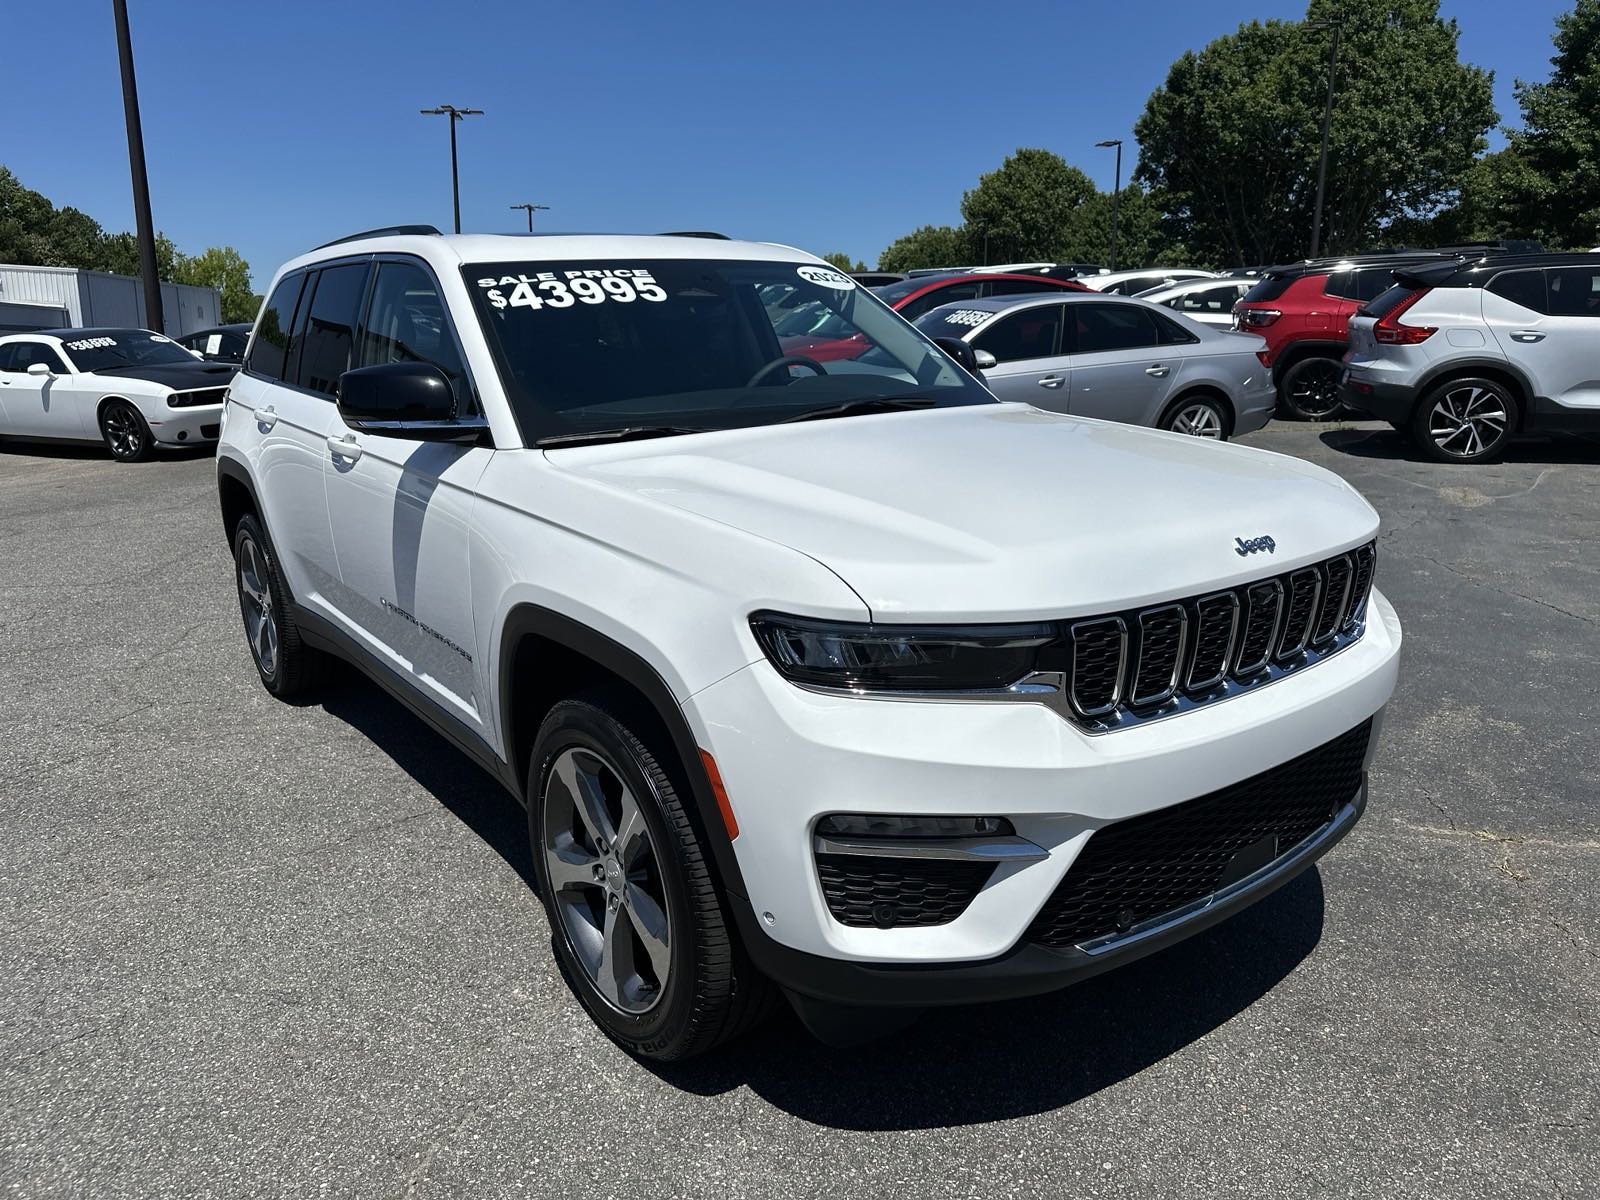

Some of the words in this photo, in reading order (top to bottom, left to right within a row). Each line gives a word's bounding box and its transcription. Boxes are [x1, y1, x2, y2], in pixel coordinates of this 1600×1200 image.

[477, 272, 558, 288] SALE
[563, 269, 652, 280] PRICE
[801, 271, 851, 284] 2023
[487, 276, 668, 310] $43995
[1234, 535, 1276, 557] Jeep
